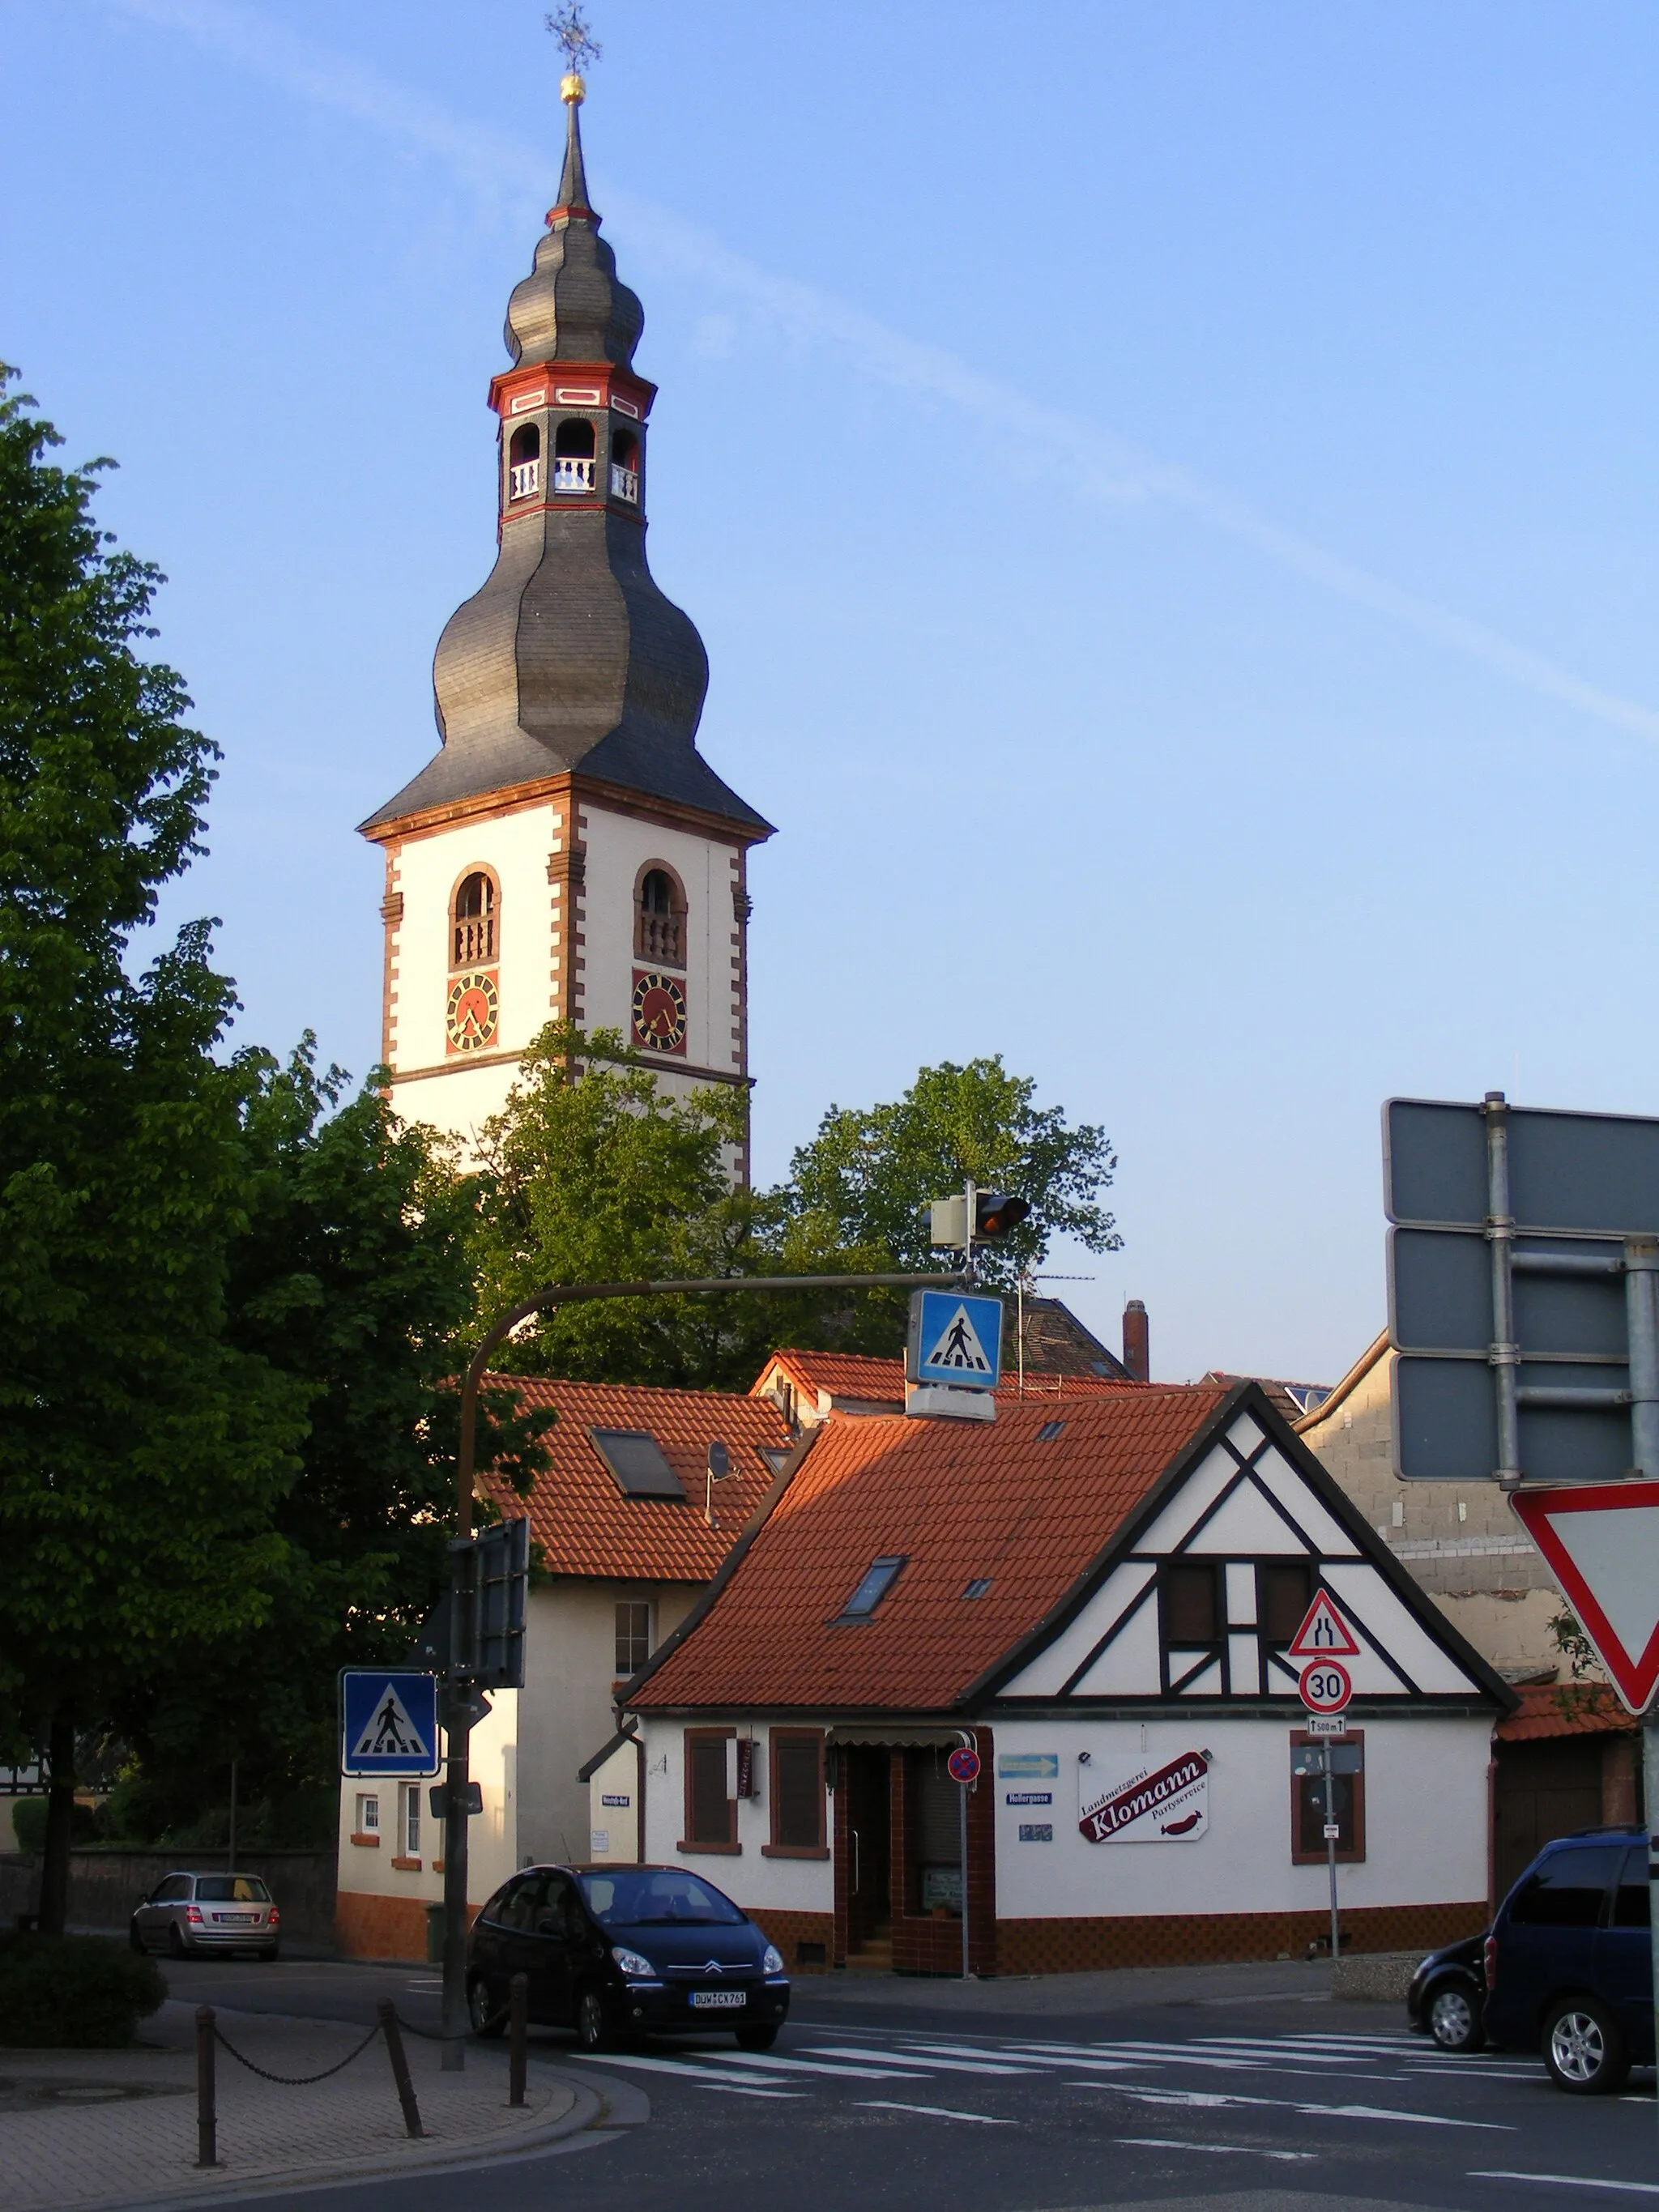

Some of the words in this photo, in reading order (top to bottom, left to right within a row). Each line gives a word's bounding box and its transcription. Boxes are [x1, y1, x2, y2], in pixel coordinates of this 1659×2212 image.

[1311, 1674, 1341, 1698] 30
[1317, 1723, 1329, 1731] 500
[1081, 1767, 1148, 1816] Landmetzgerei
[1090, 1762, 1200, 1840] Klomann
[1151, 1781, 1206, 1820] Partyservice
